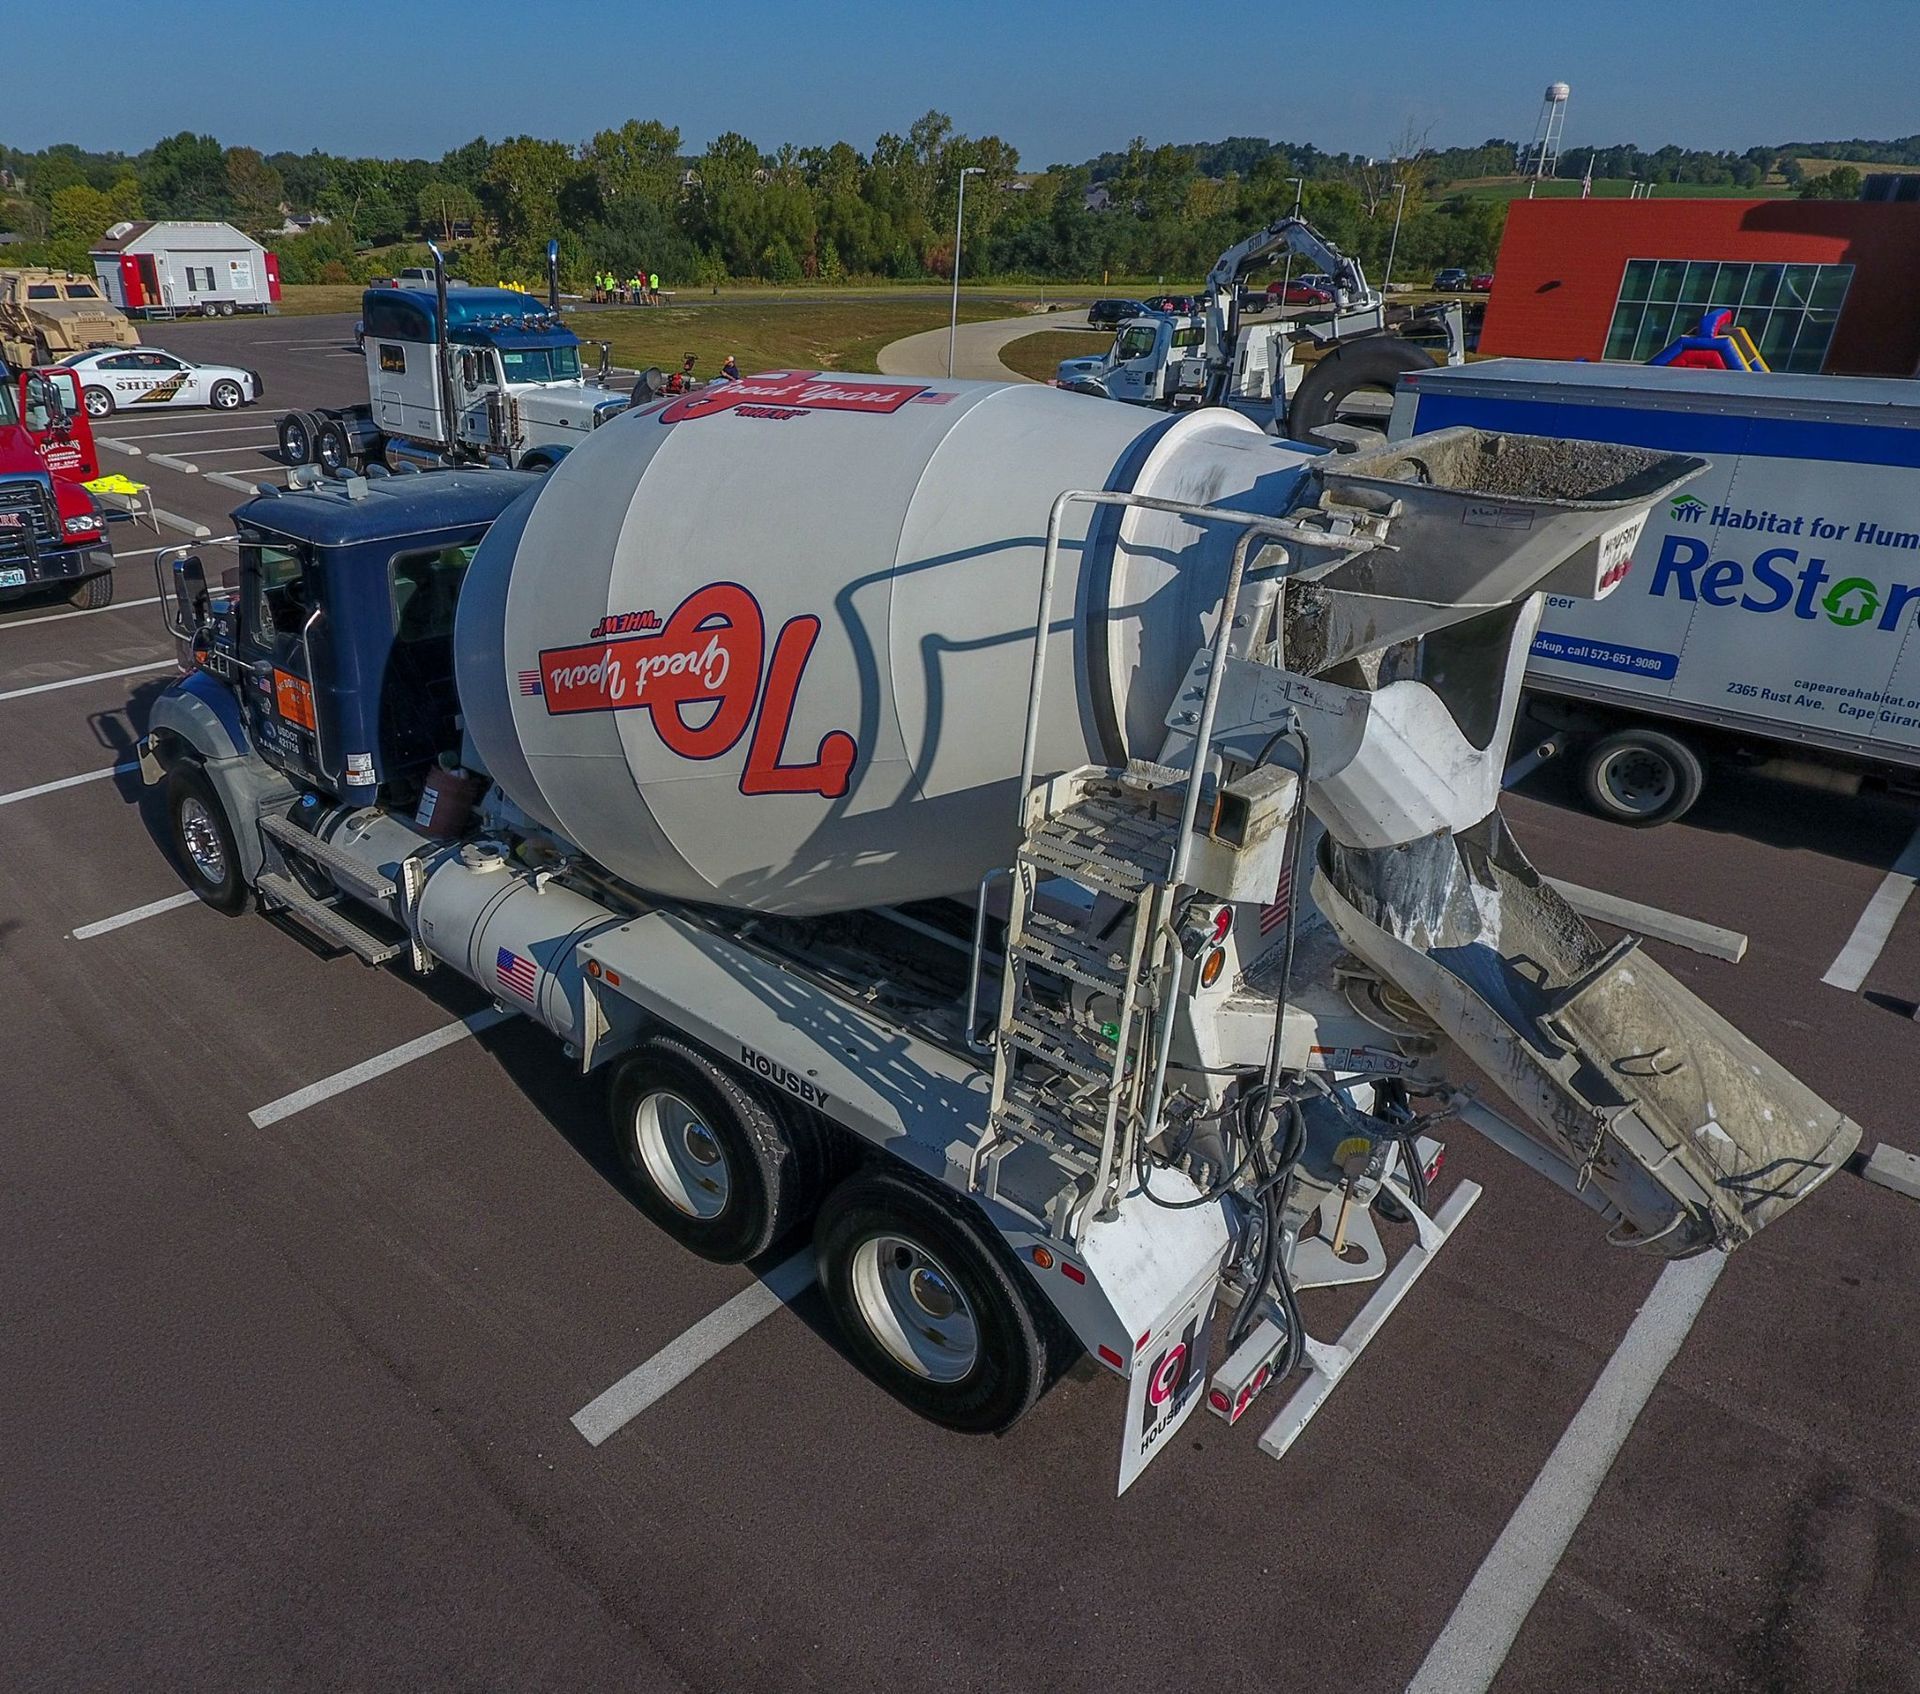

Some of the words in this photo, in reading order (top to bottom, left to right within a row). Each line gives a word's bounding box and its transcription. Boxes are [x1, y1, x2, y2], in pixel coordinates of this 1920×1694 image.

[115, 379, 198, 391] SHERIFF
[795, 384, 902, 404] Years
[1709, 506, 1804, 536] Habitat
[1809, 517, 1850, 541] for
[1854, 522, 1920, 550] Hum
[1648, 534, 1920, 632] ReStor
[590, 610, 663, 639] "WHEW!"
[550, 648, 626, 700] Years
[635, 634, 730, 697] Great
[1531, 637, 1565, 655] ickup,
[1567, 644, 1588, 658] call
[1590, 650, 1662, 671] 573-651-9080
[648, 581, 858, 799] 70
[1726, 682, 1759, 698] 2365
[1760, 688, 1793, 704] Rust
[1794, 695, 1826, 711] Ave.
[1838, 702, 1876, 720] Cape
[741, 1045, 830, 1109] HOUSBY
[1140, 1391, 1191, 1456] HOUSBY
